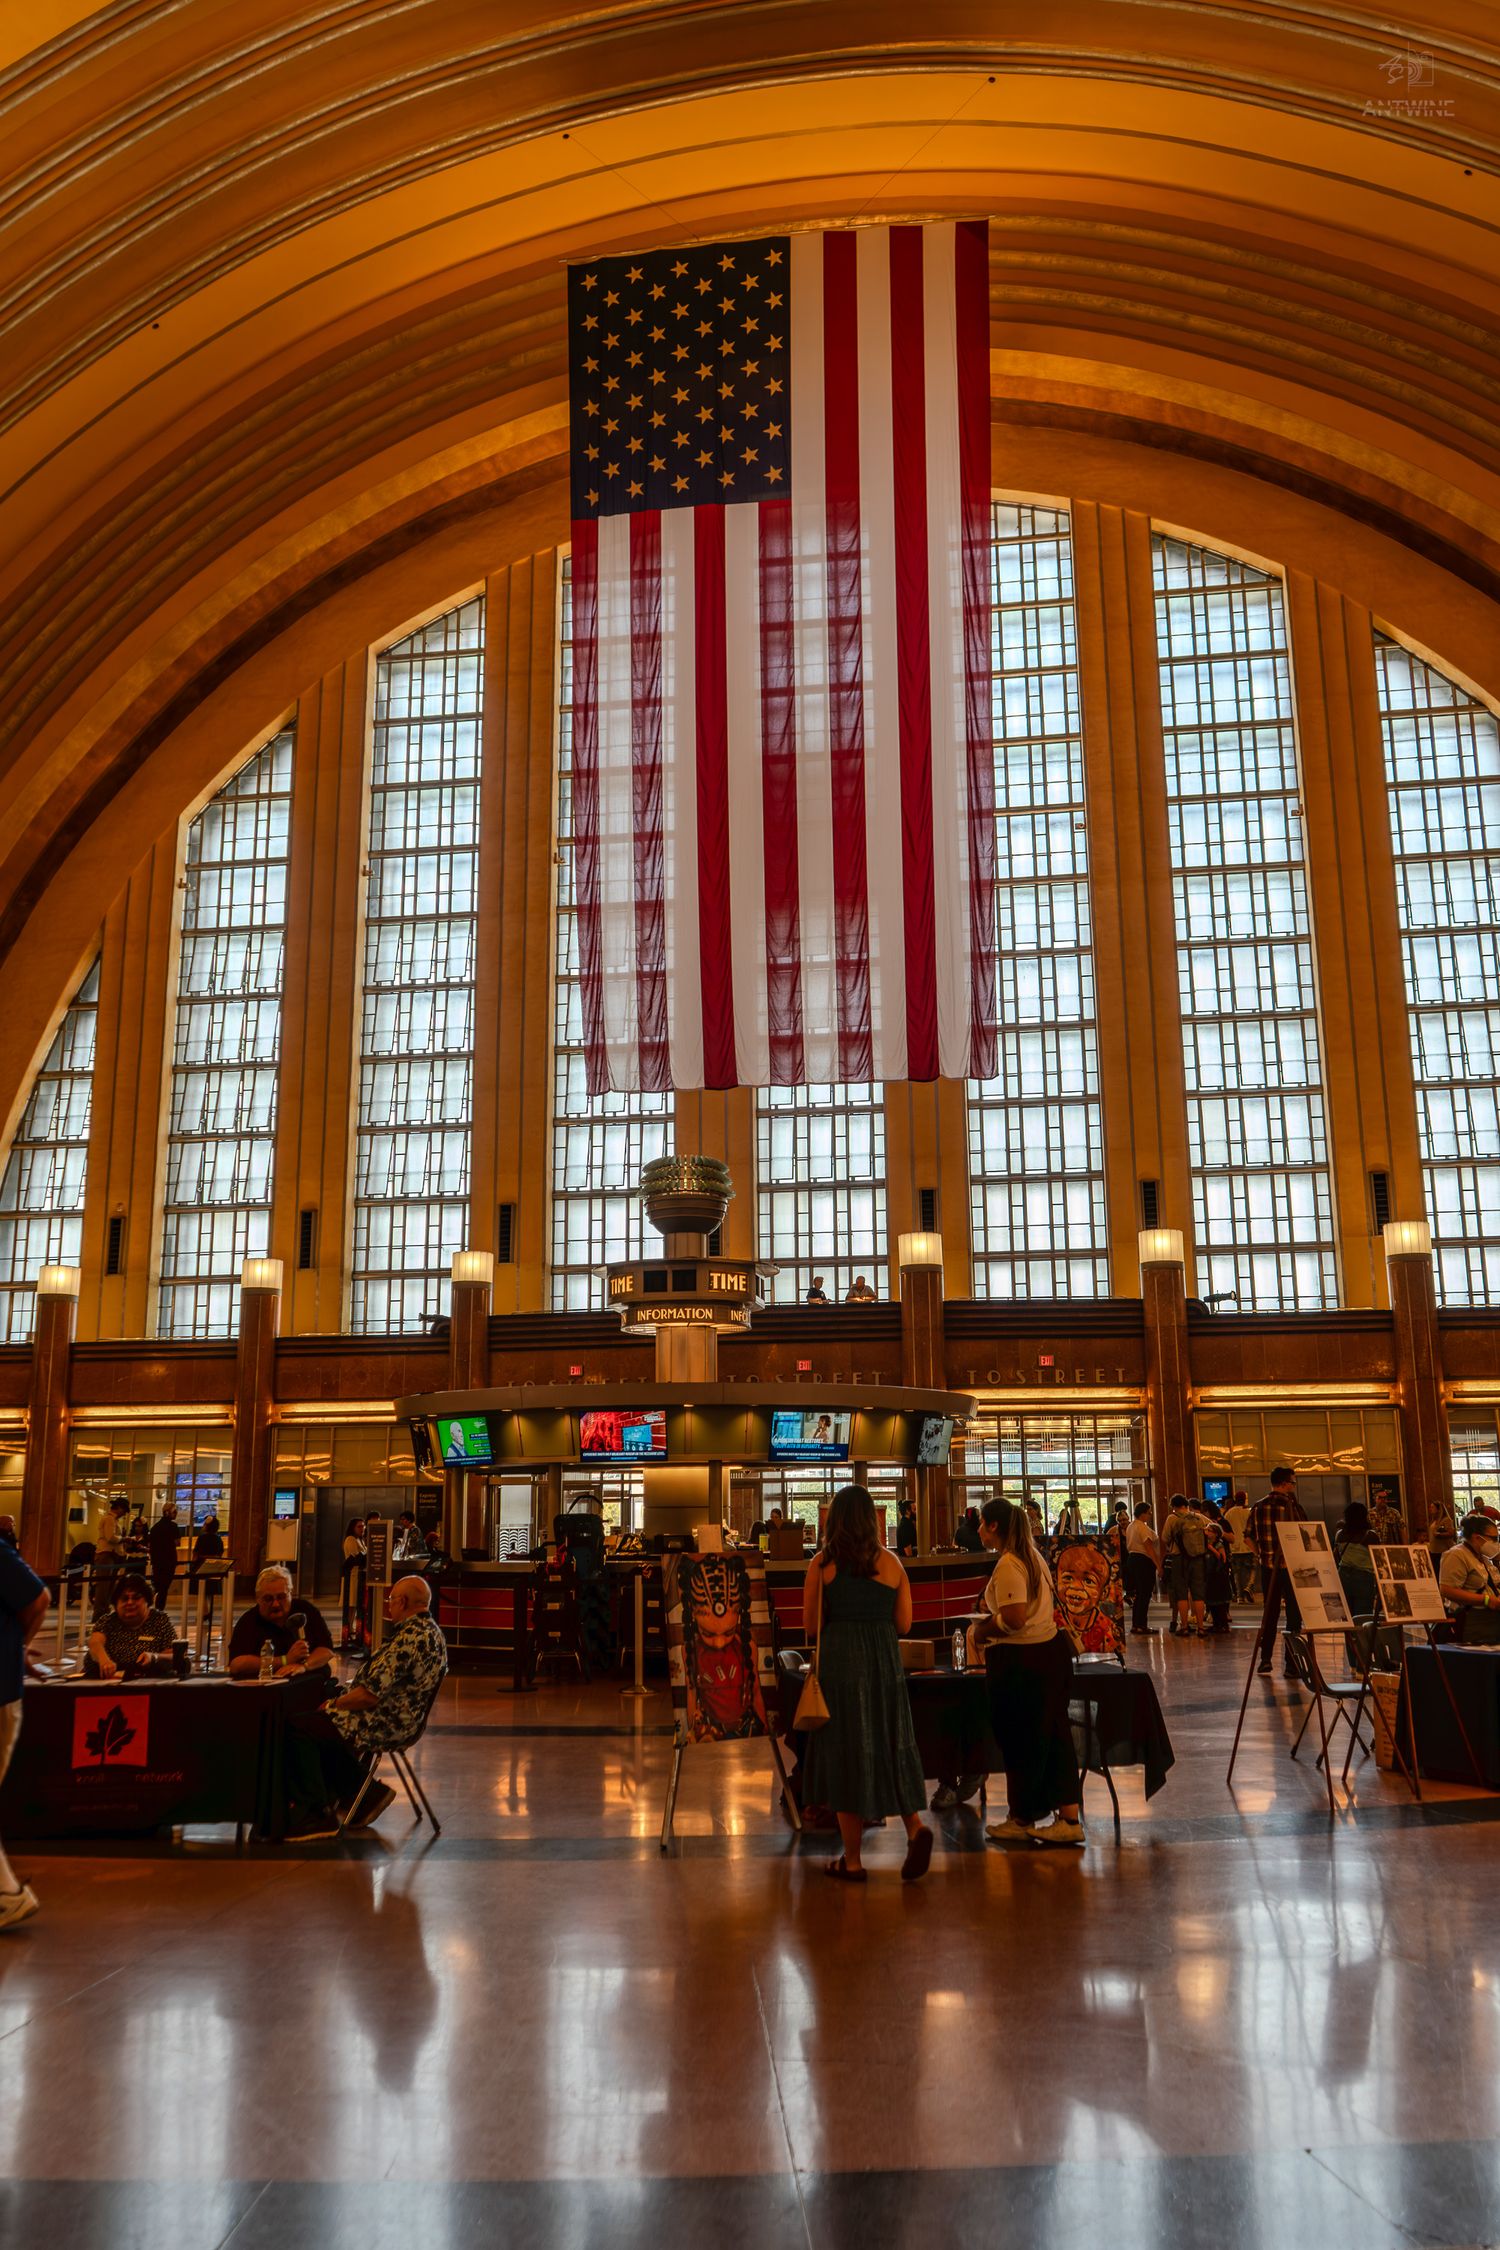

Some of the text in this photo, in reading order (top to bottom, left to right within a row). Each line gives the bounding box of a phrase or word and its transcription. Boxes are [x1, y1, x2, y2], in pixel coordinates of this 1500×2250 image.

[610, 1275, 634, 1295] TIME
[709, 1272, 747, 1292] TIME
[637, 1307, 713, 1322] INFORMATION
[967, 1368, 1126, 1385] TO STREET
